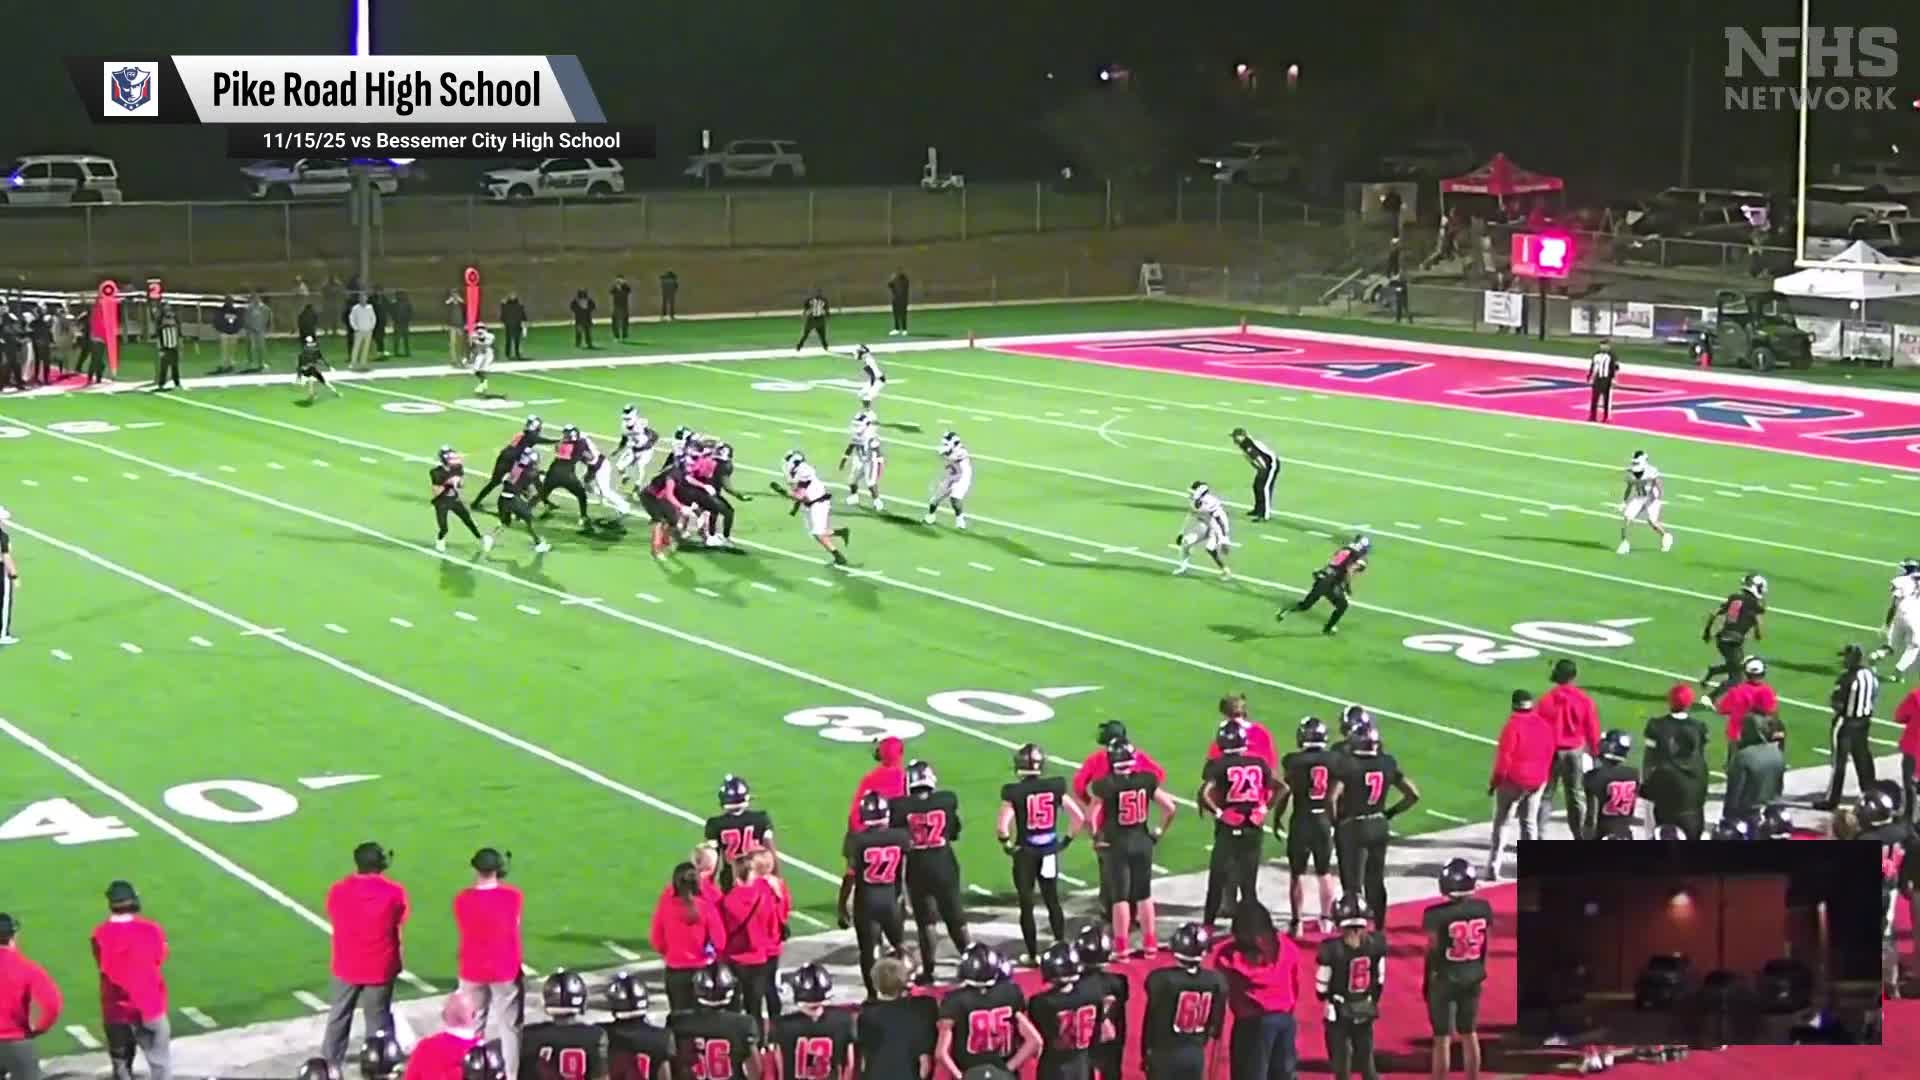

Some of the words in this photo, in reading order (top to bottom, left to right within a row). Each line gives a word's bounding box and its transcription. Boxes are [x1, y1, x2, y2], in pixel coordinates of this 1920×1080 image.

[1402, 621, 1635, 664] 20
[784, 690, 1055, 742] 30
[1226, 765, 1263, 802] 23
[1364, 771, 1383, 805] 7
[0, 779, 299, 845] 40
[1026, 792, 1054, 830] 15
[1118, 788, 1148, 826] 51
[1446, 918, 1486, 961] 35
[967, 1005, 1012, 1056] 85
[1173, 991, 1212, 1033] 61
